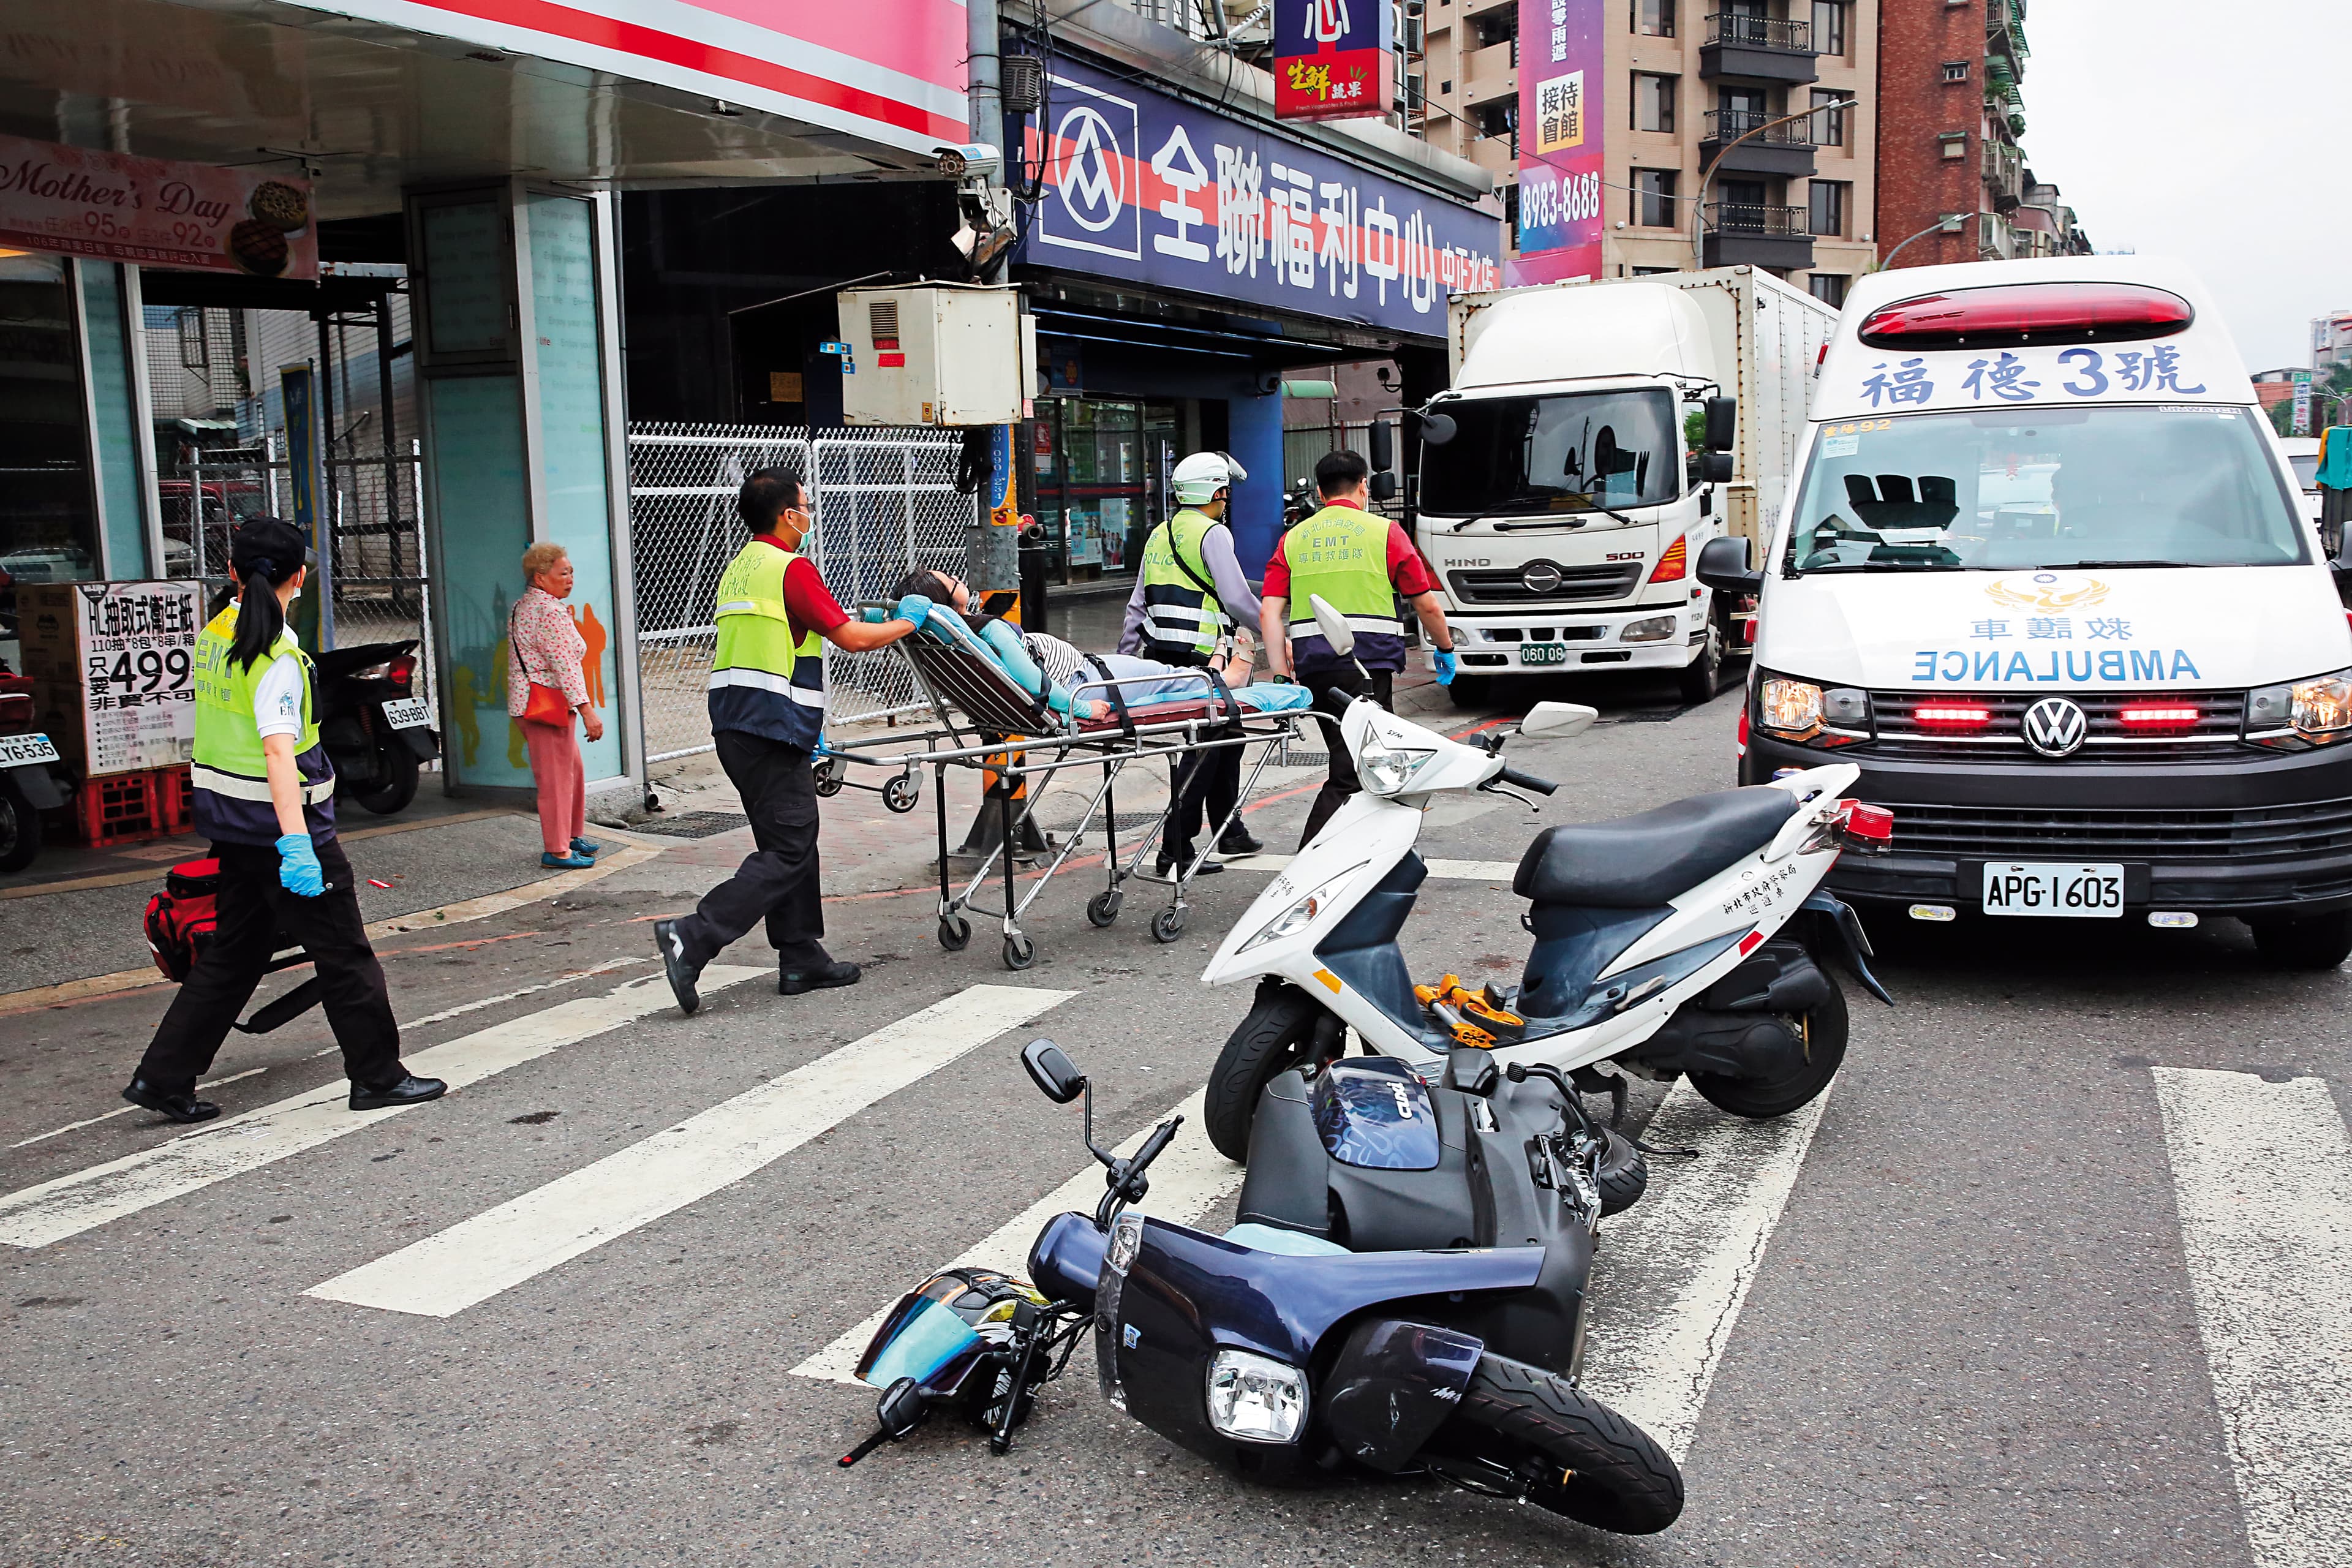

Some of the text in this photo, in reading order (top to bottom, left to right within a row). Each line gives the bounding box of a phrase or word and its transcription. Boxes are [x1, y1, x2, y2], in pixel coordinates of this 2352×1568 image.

[1287, 58, 1362, 101] 生鮮 蔬果
[1542, 81, 1578, 115] 接待
[1542, 111, 1578, 145] 會館
[0, 160, 142, 209] Mother's
[156, 181, 230, 228] Day
[1523, 171, 1599, 230] 8983-8688
[1152, 124, 1436, 314] 全聯福利中心
[1860, 345, 2206, 408] 福德3號
[1298, 548, 1363, 564] 專責救護隊
[1313, 535, 1349, 548] EMT
[1606, 551, 1645, 561] 500
[1444, 558, 1491, 567] HINO
[89, 649, 190, 696] 只要 499
[89, 688, 195, 710] 非買不可
[388, 706, 430, 725] 639-BBT
[1387, 729, 1403, 739] SYM
[1723, 864, 1796, 915] 新北市政府警察局
[1986, 875, 2120, 908] APG-1603
